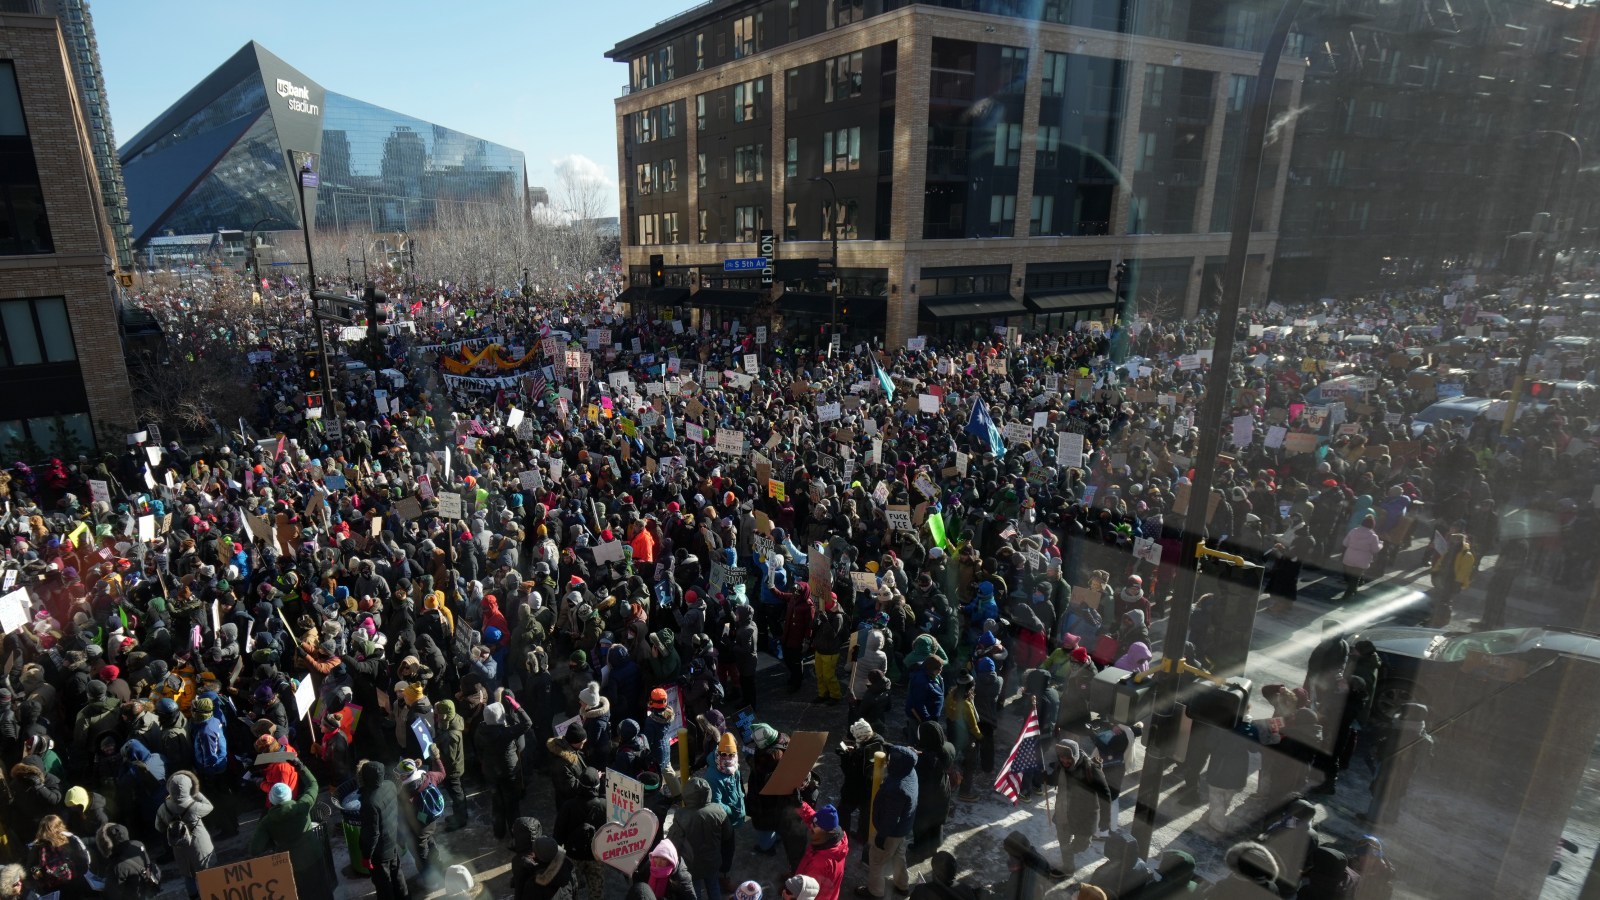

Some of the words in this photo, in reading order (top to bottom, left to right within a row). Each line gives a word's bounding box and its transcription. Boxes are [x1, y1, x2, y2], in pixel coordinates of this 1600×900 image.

[288, 98, 319, 116] stadium
[741, 260, 754, 268] 5th
[756, 260, 766, 268] Av
[544, 339, 555, 350] ICE
[889, 513, 908, 521] FUCK
[892, 521, 909, 530] ICE
[851, 572, 865, 581] ICE
[606, 779, 610, 788] I
[611, 793, 634, 813] HATE
[606, 827, 639, 843] ARMED
[602, 838, 647, 861] EMPATHY
[223, 862, 253, 884] MN
